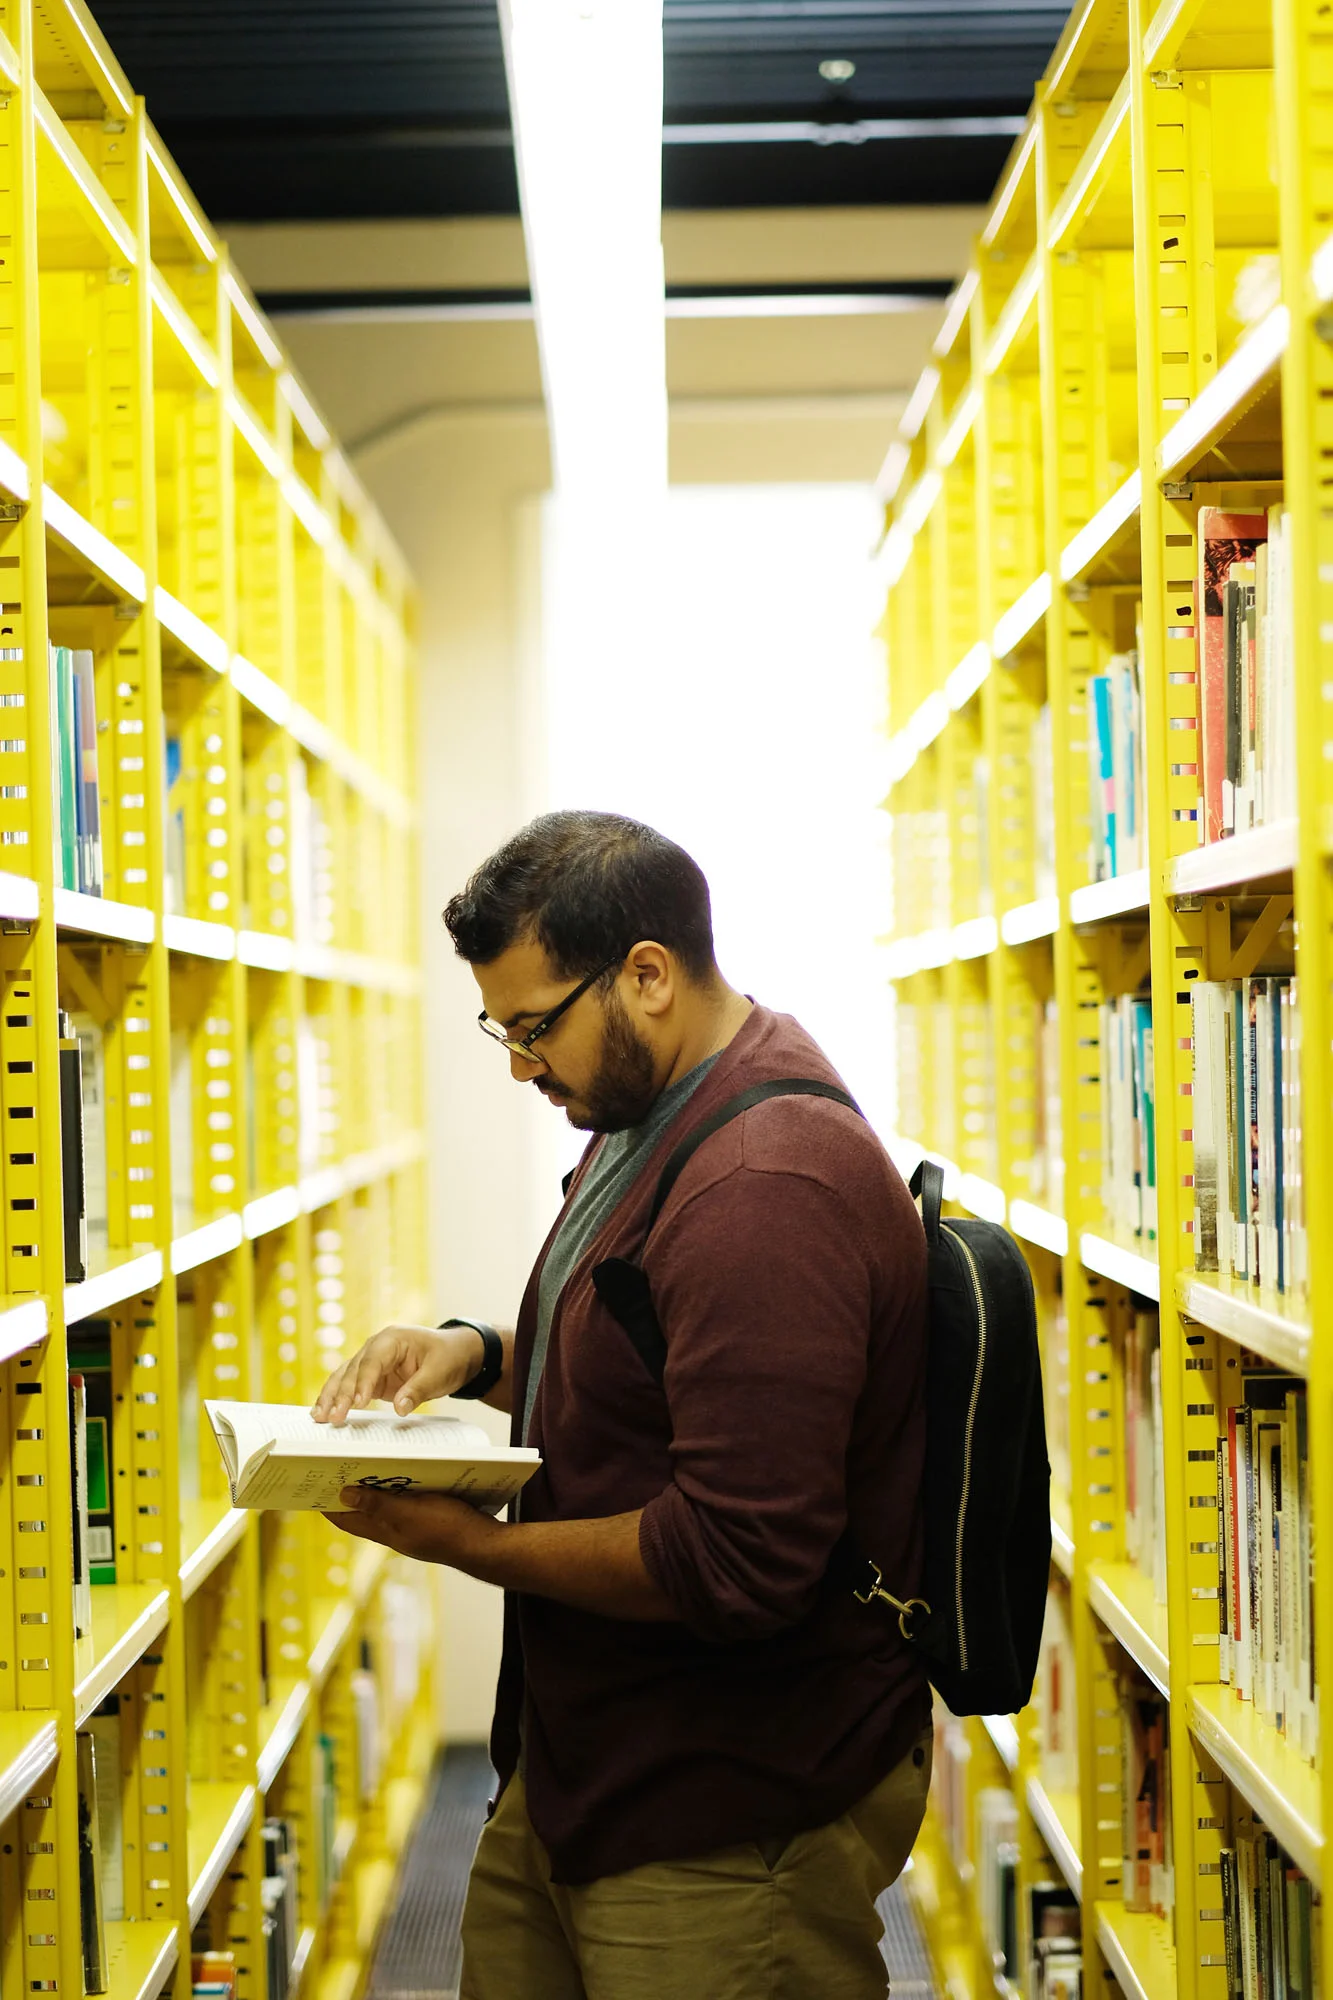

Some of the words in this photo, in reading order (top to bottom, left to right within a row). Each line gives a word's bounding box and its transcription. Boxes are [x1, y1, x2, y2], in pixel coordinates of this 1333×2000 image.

[292, 1469, 326, 1498] MARKET
[311, 1486, 338, 1509] MIND
[328, 1462, 361, 1487] GAMES
